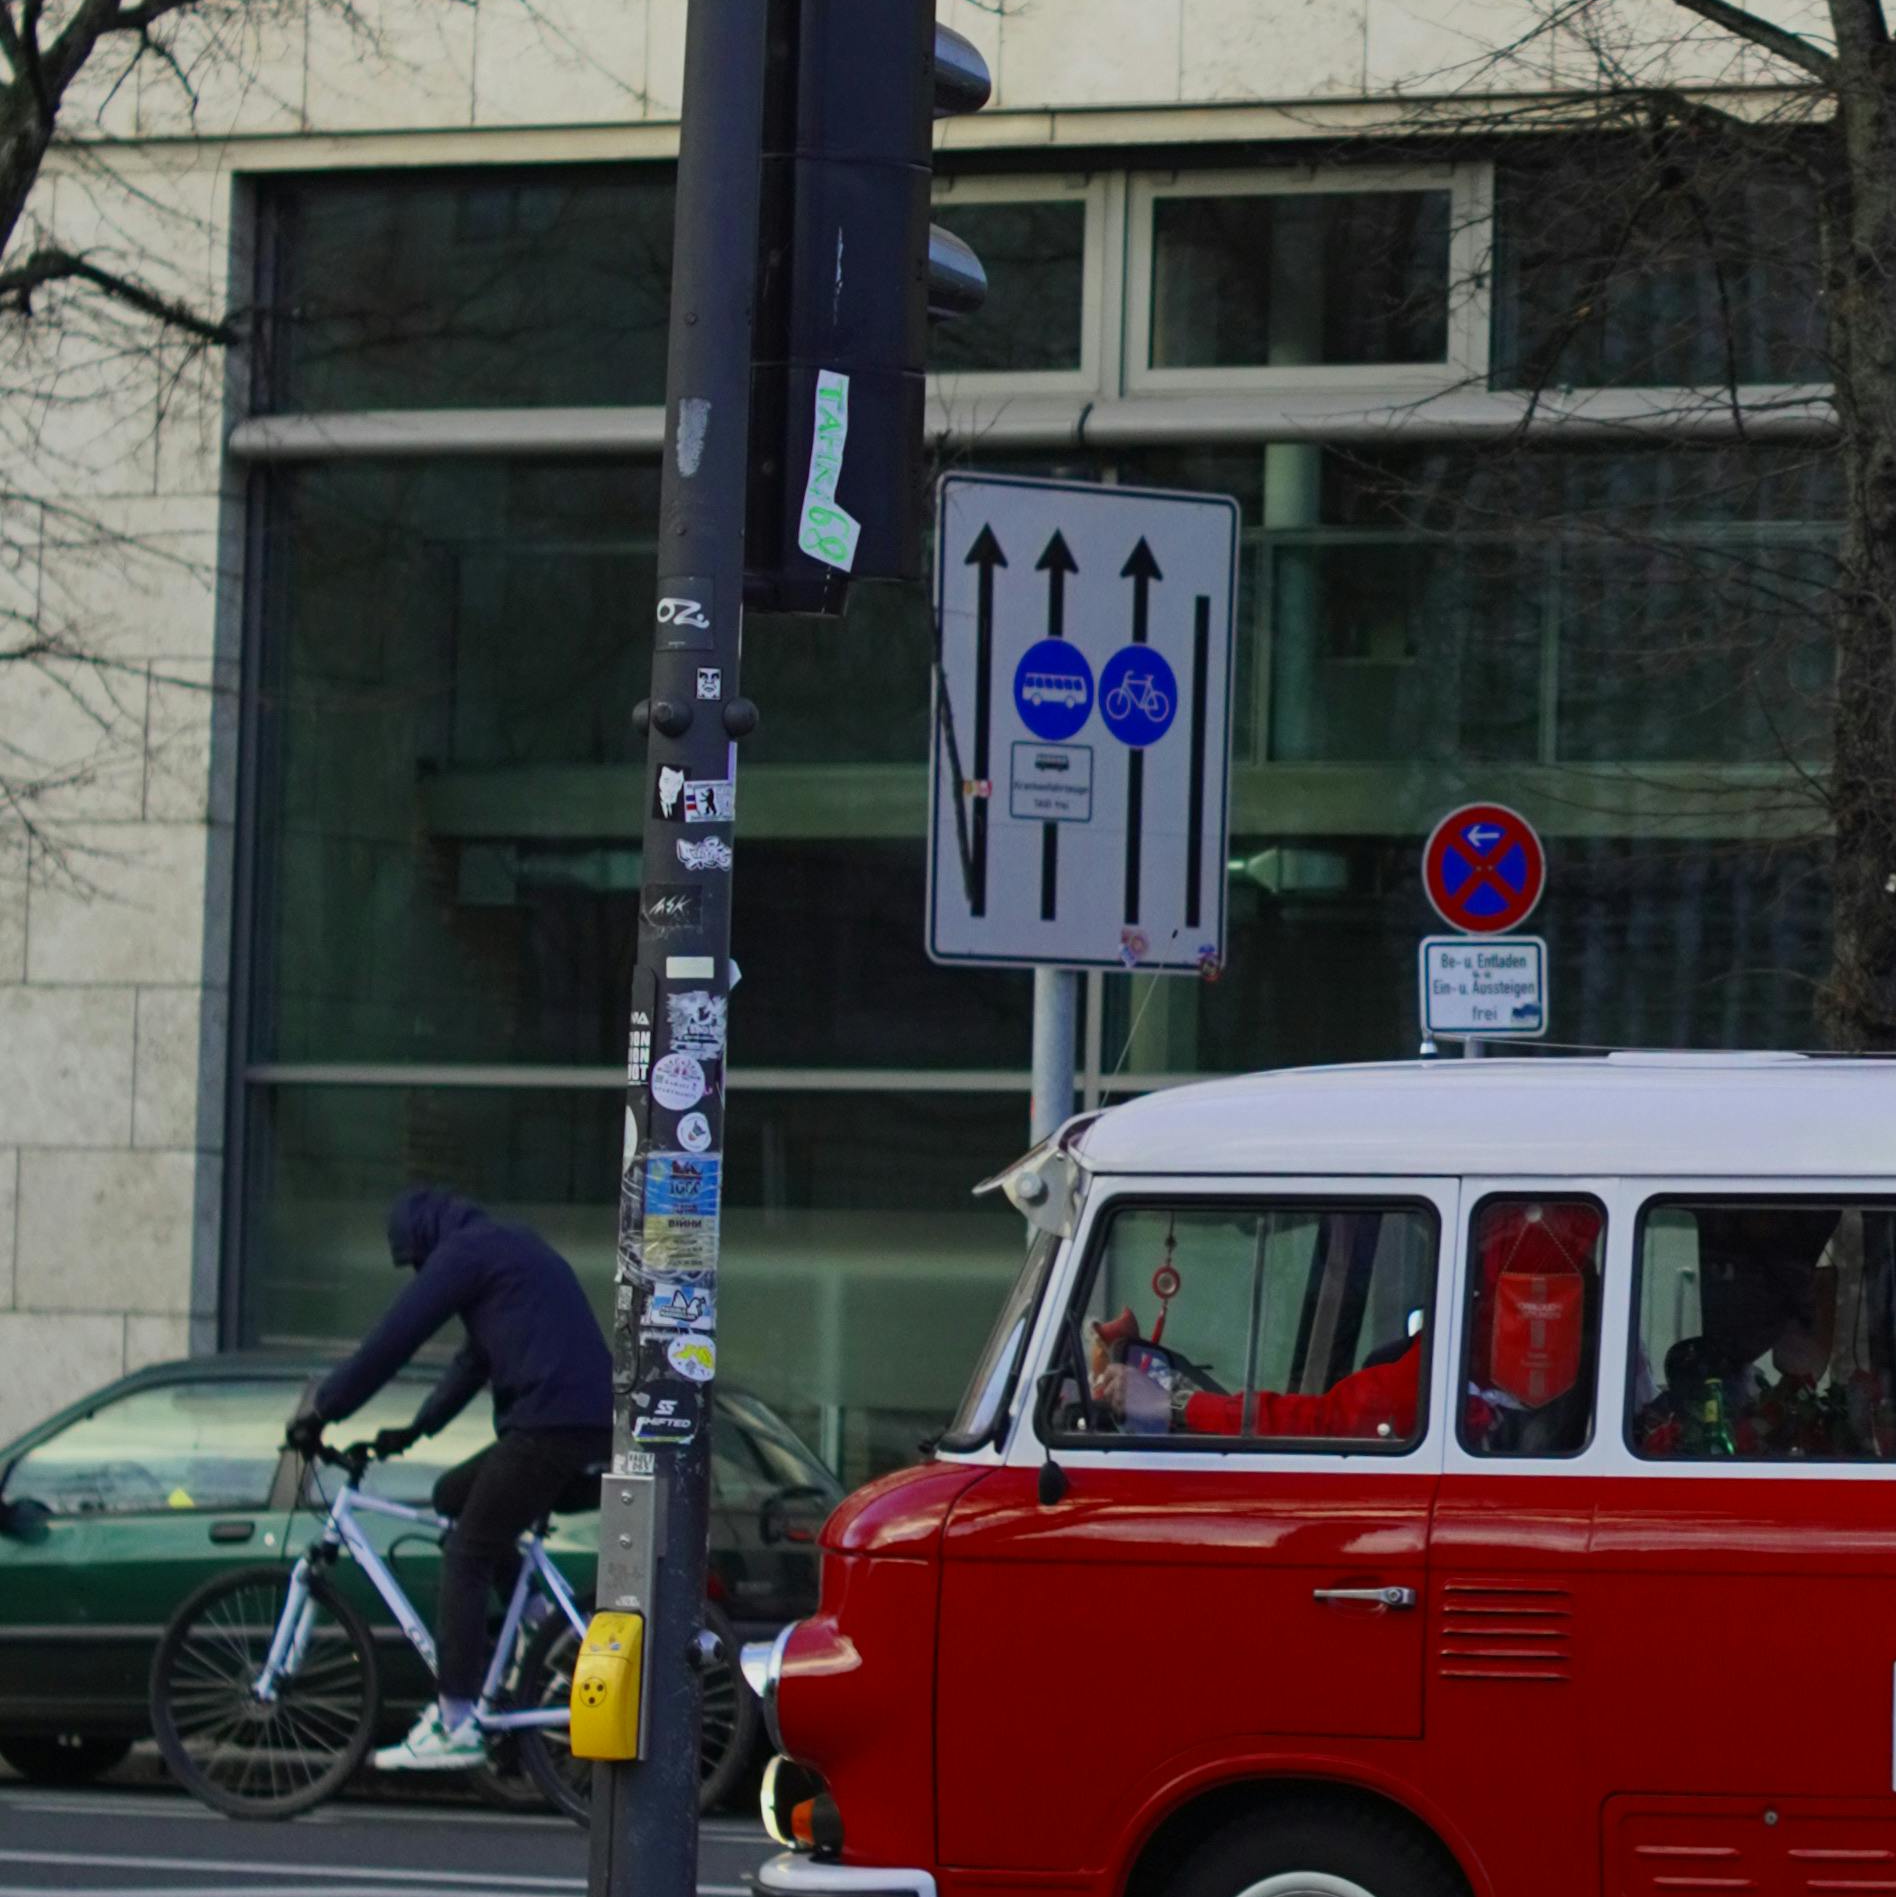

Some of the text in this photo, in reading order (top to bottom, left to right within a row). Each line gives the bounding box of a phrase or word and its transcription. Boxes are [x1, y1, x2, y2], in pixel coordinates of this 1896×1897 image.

[1477, 952, 1527, 969] Entladen
[1472, 980, 1536, 998] Aussteigen
[1472, 1005, 1498, 1021] frei
